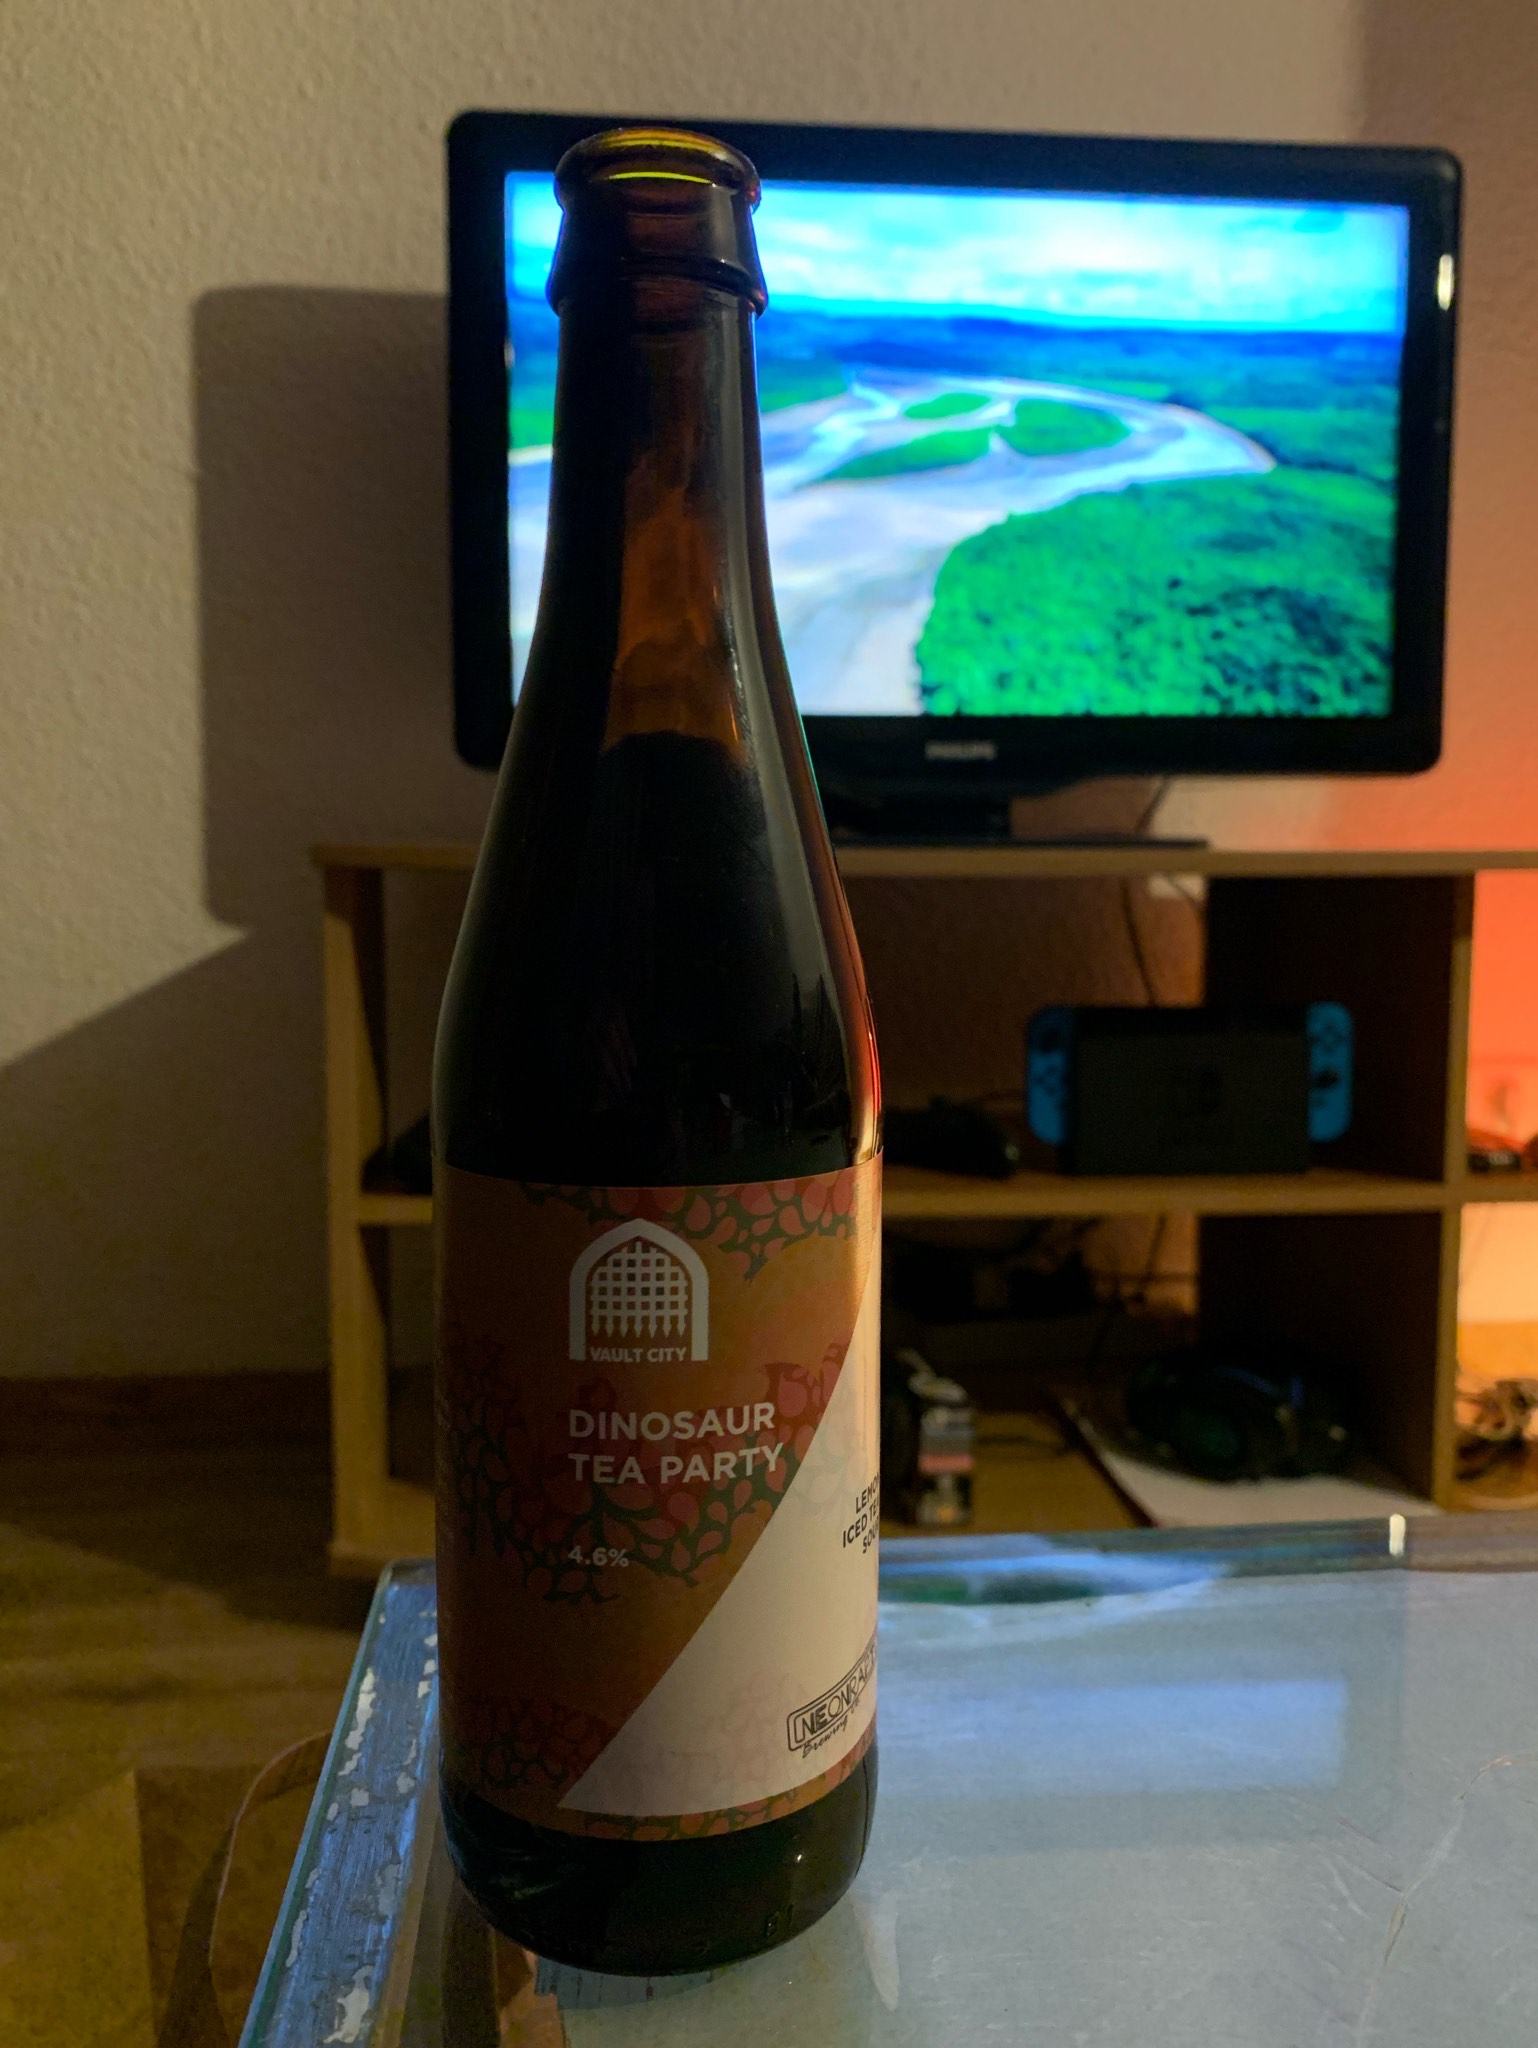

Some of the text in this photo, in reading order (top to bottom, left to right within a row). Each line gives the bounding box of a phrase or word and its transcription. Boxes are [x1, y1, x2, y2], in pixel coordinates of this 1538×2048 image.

[590, 1347, 687, 1363] VAULT CITY
[568, 1402, 776, 1441] DINOSAUR
[567, 1442, 784, 1484] TEA PARTY
[842, 1513, 868, 1548] ICED
[567, 1545, 629, 1567] 4.6%
